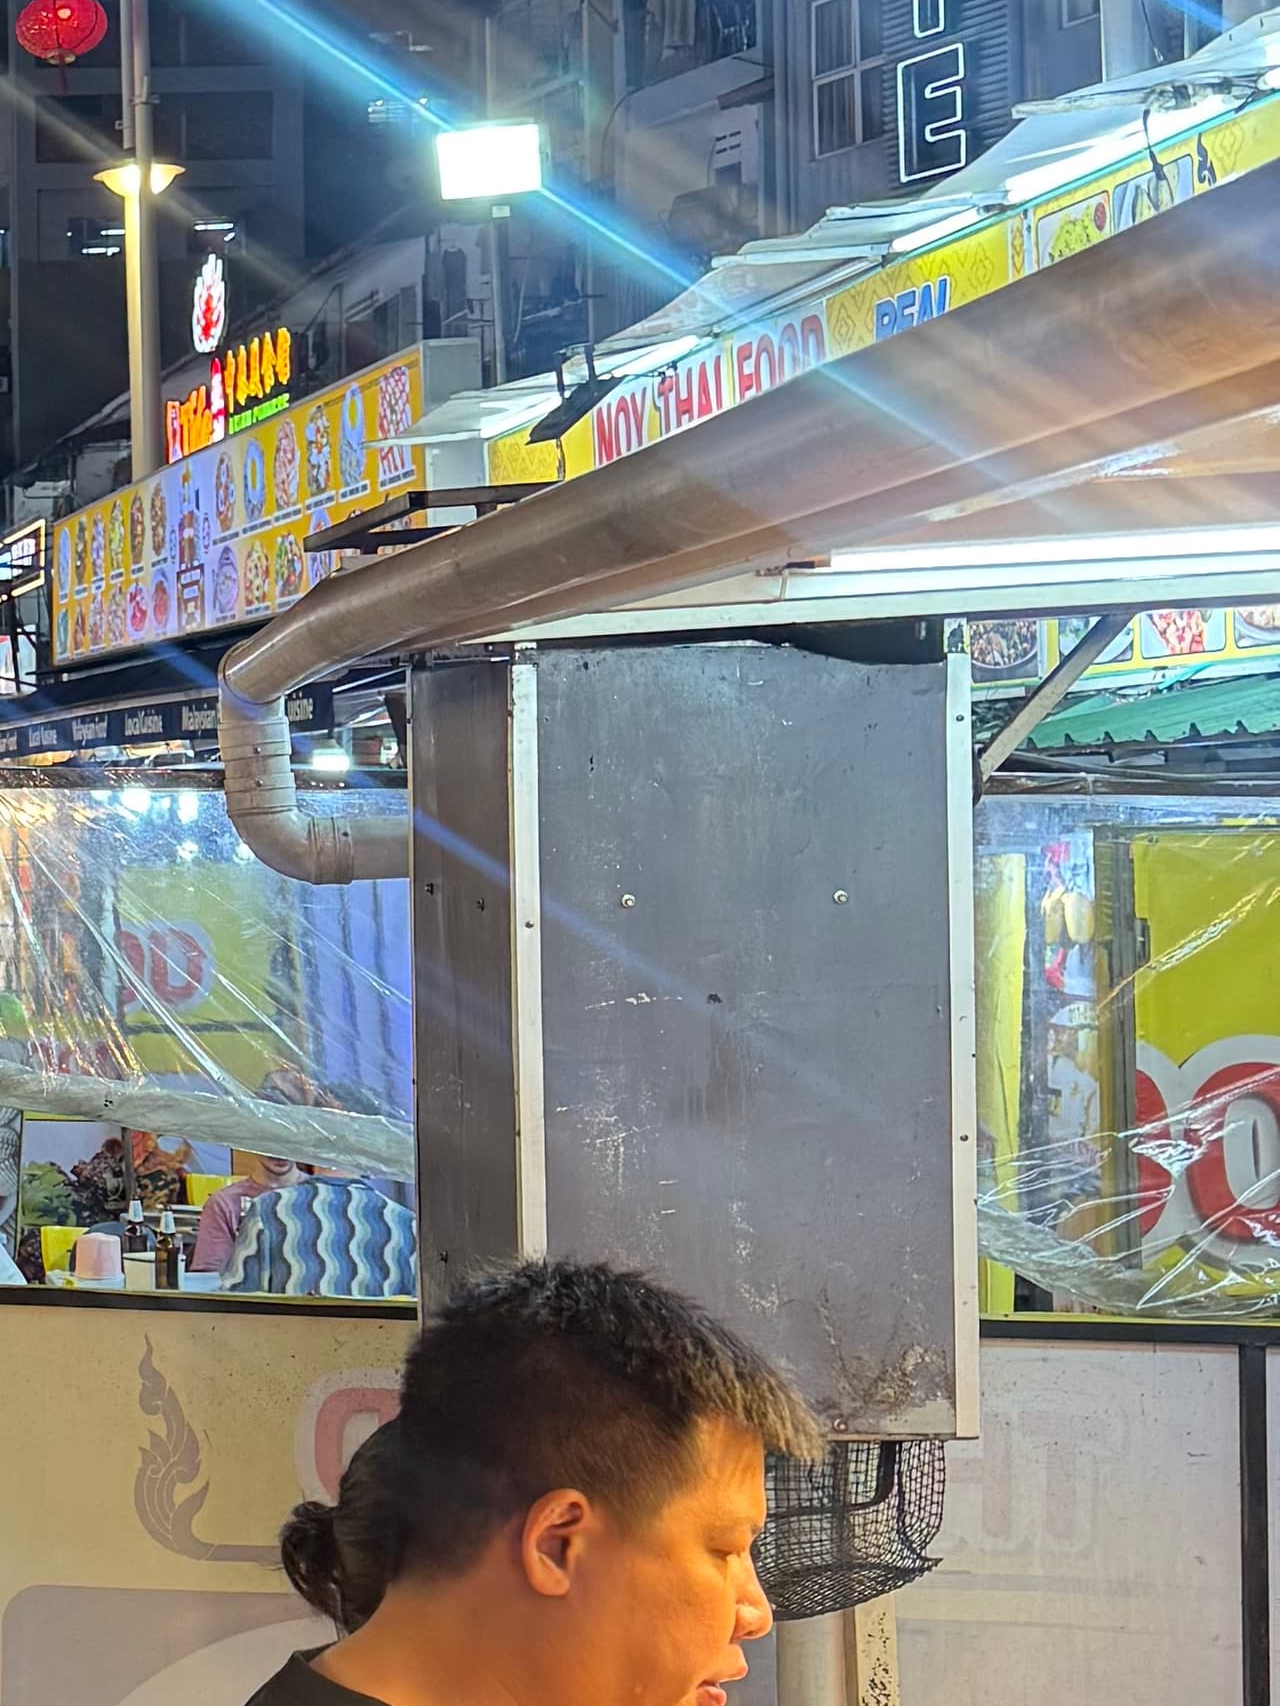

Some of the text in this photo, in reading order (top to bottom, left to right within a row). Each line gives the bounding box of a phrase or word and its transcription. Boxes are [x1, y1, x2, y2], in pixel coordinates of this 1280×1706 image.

[595, 313, 827, 466] NOY THAI FOOD
[181, 702, 216, 737] Malaysian
